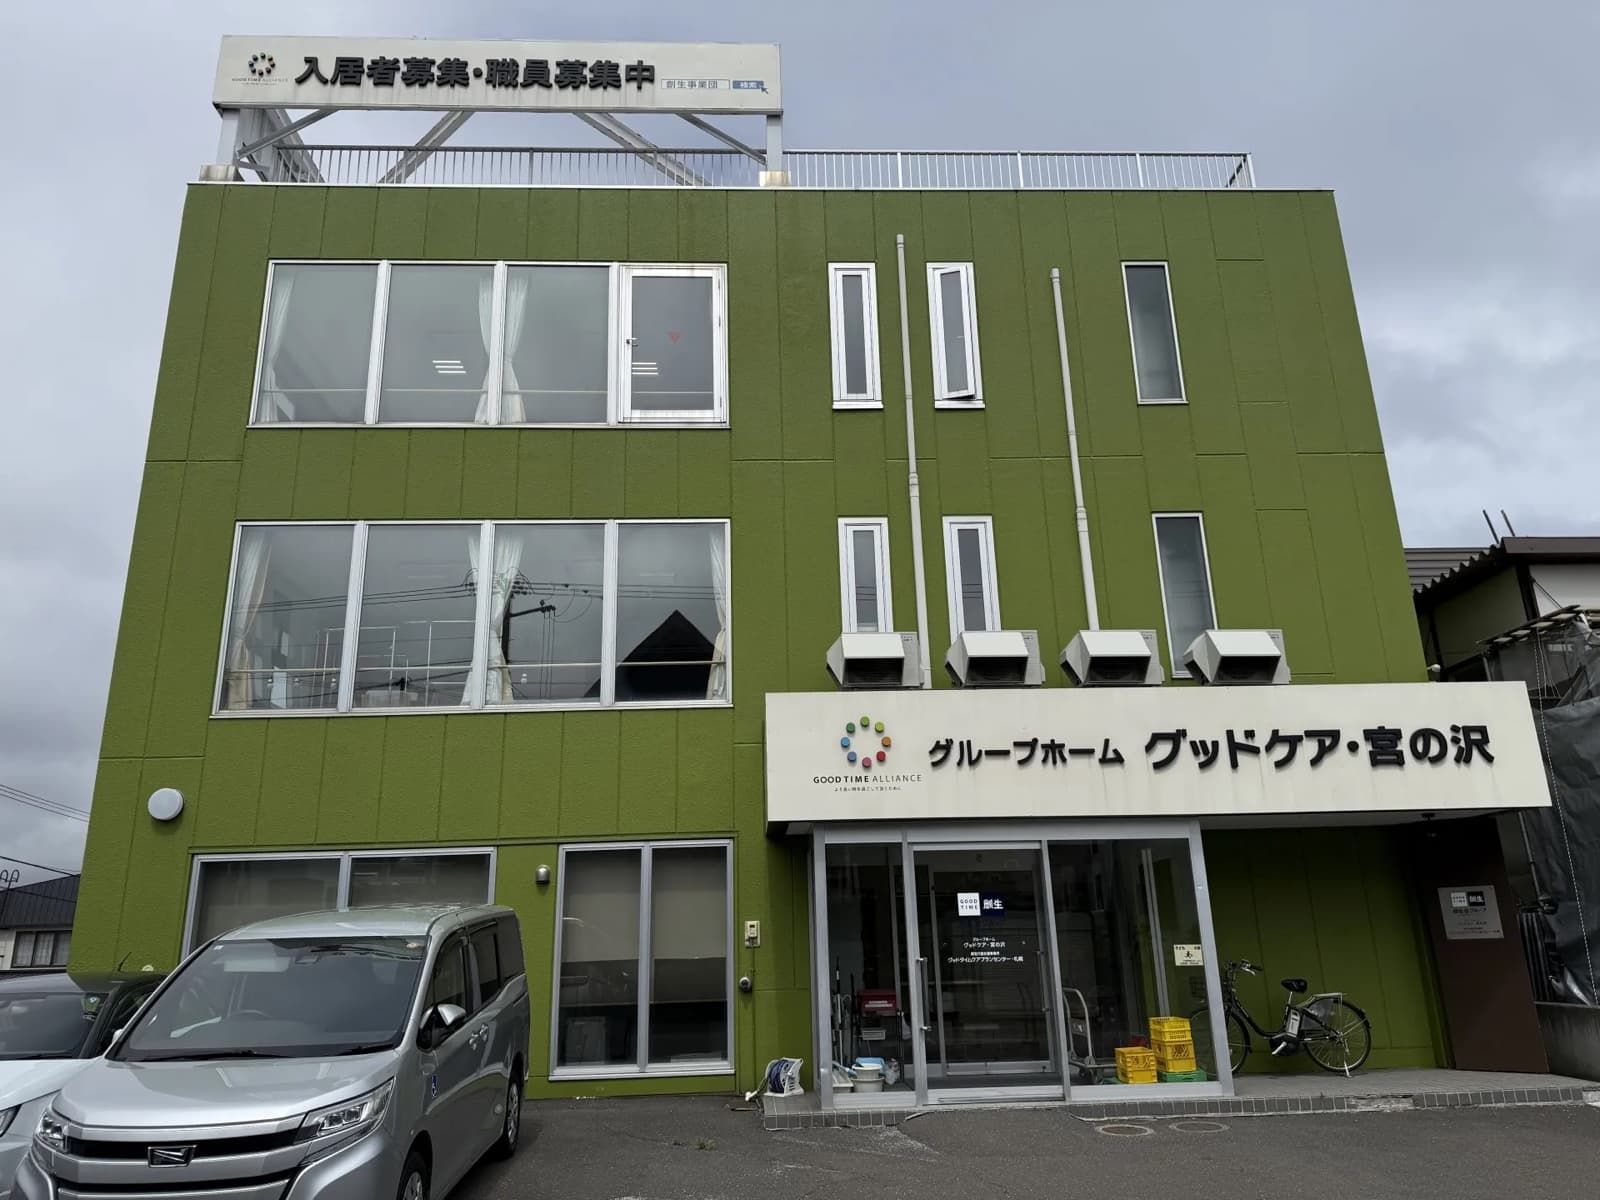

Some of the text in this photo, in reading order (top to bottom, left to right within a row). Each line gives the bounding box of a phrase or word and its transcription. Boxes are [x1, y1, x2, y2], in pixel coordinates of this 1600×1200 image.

[295, 56, 655, 89] 入居者募集・職員募集中
[929, 725, 1495, 769] グループホーム グッドケア・宮の沢
[813, 774, 923, 784] GOOD TIME ALLIANCE
